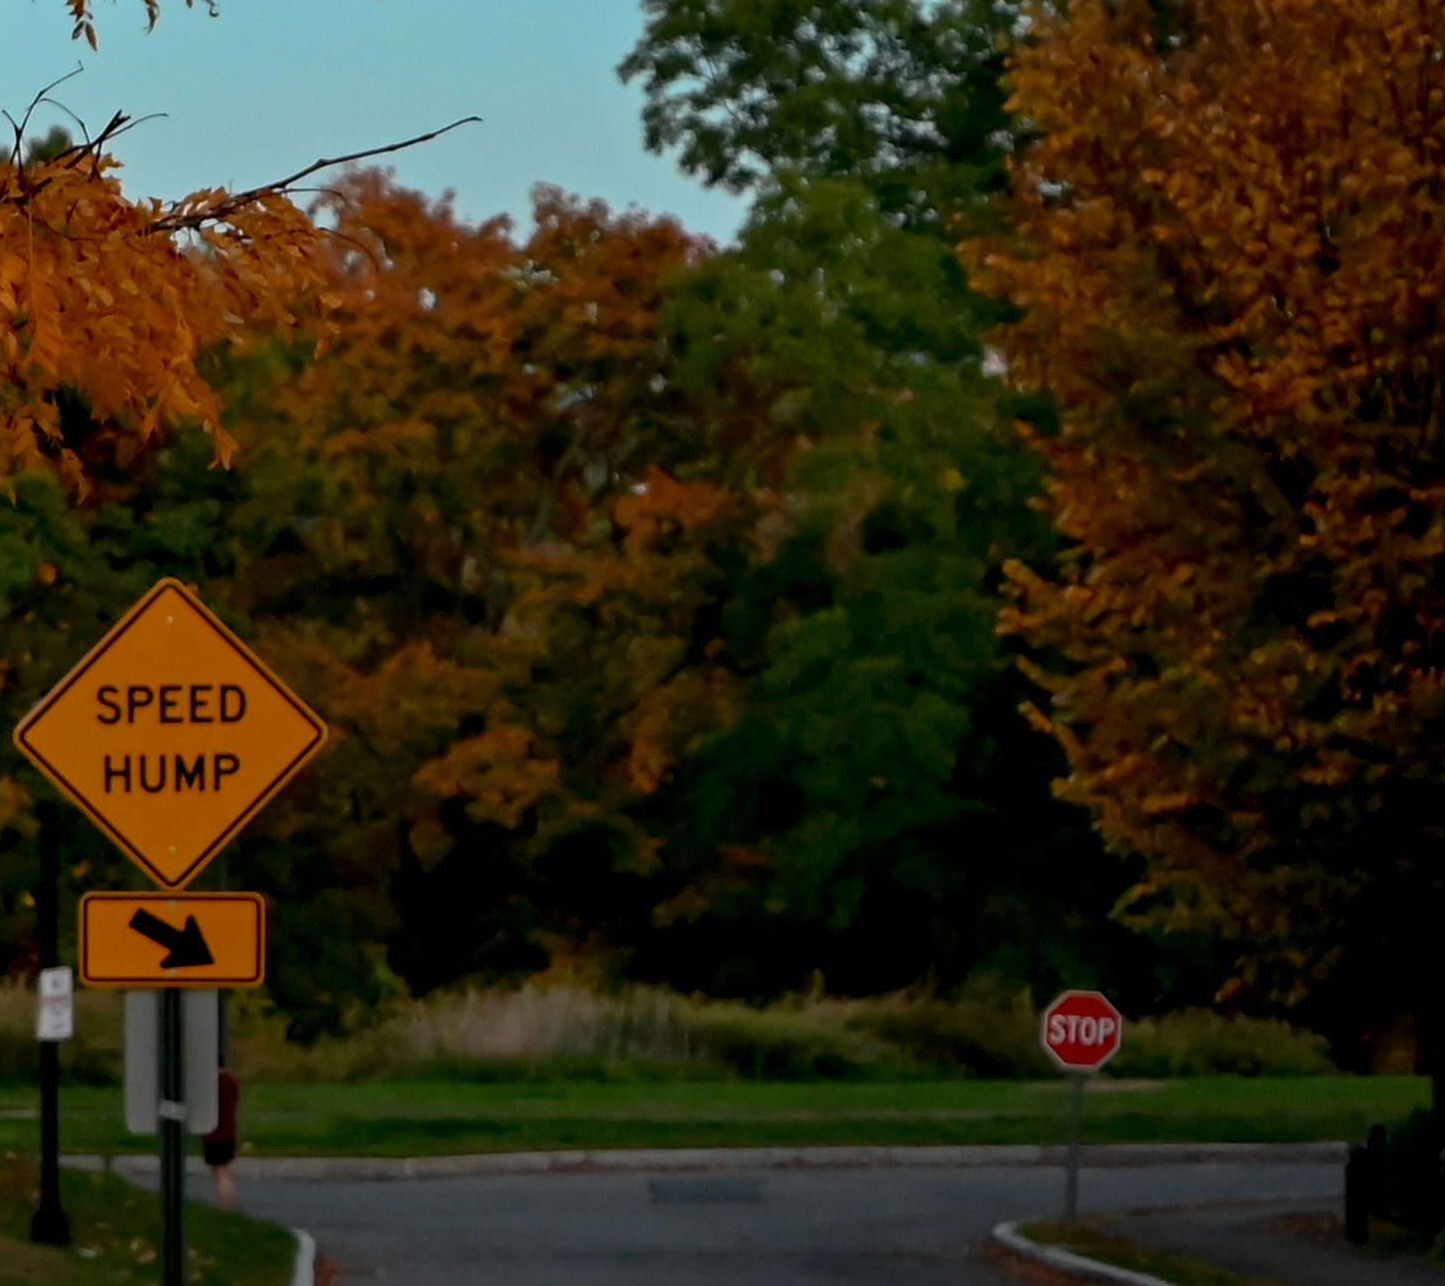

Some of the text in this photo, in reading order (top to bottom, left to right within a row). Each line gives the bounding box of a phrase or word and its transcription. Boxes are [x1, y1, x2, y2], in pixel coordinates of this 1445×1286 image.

[97, 685, 246, 725] SPEED
[104, 753, 240, 793] HUMP
[1050, 1014, 1115, 1046] STOP
